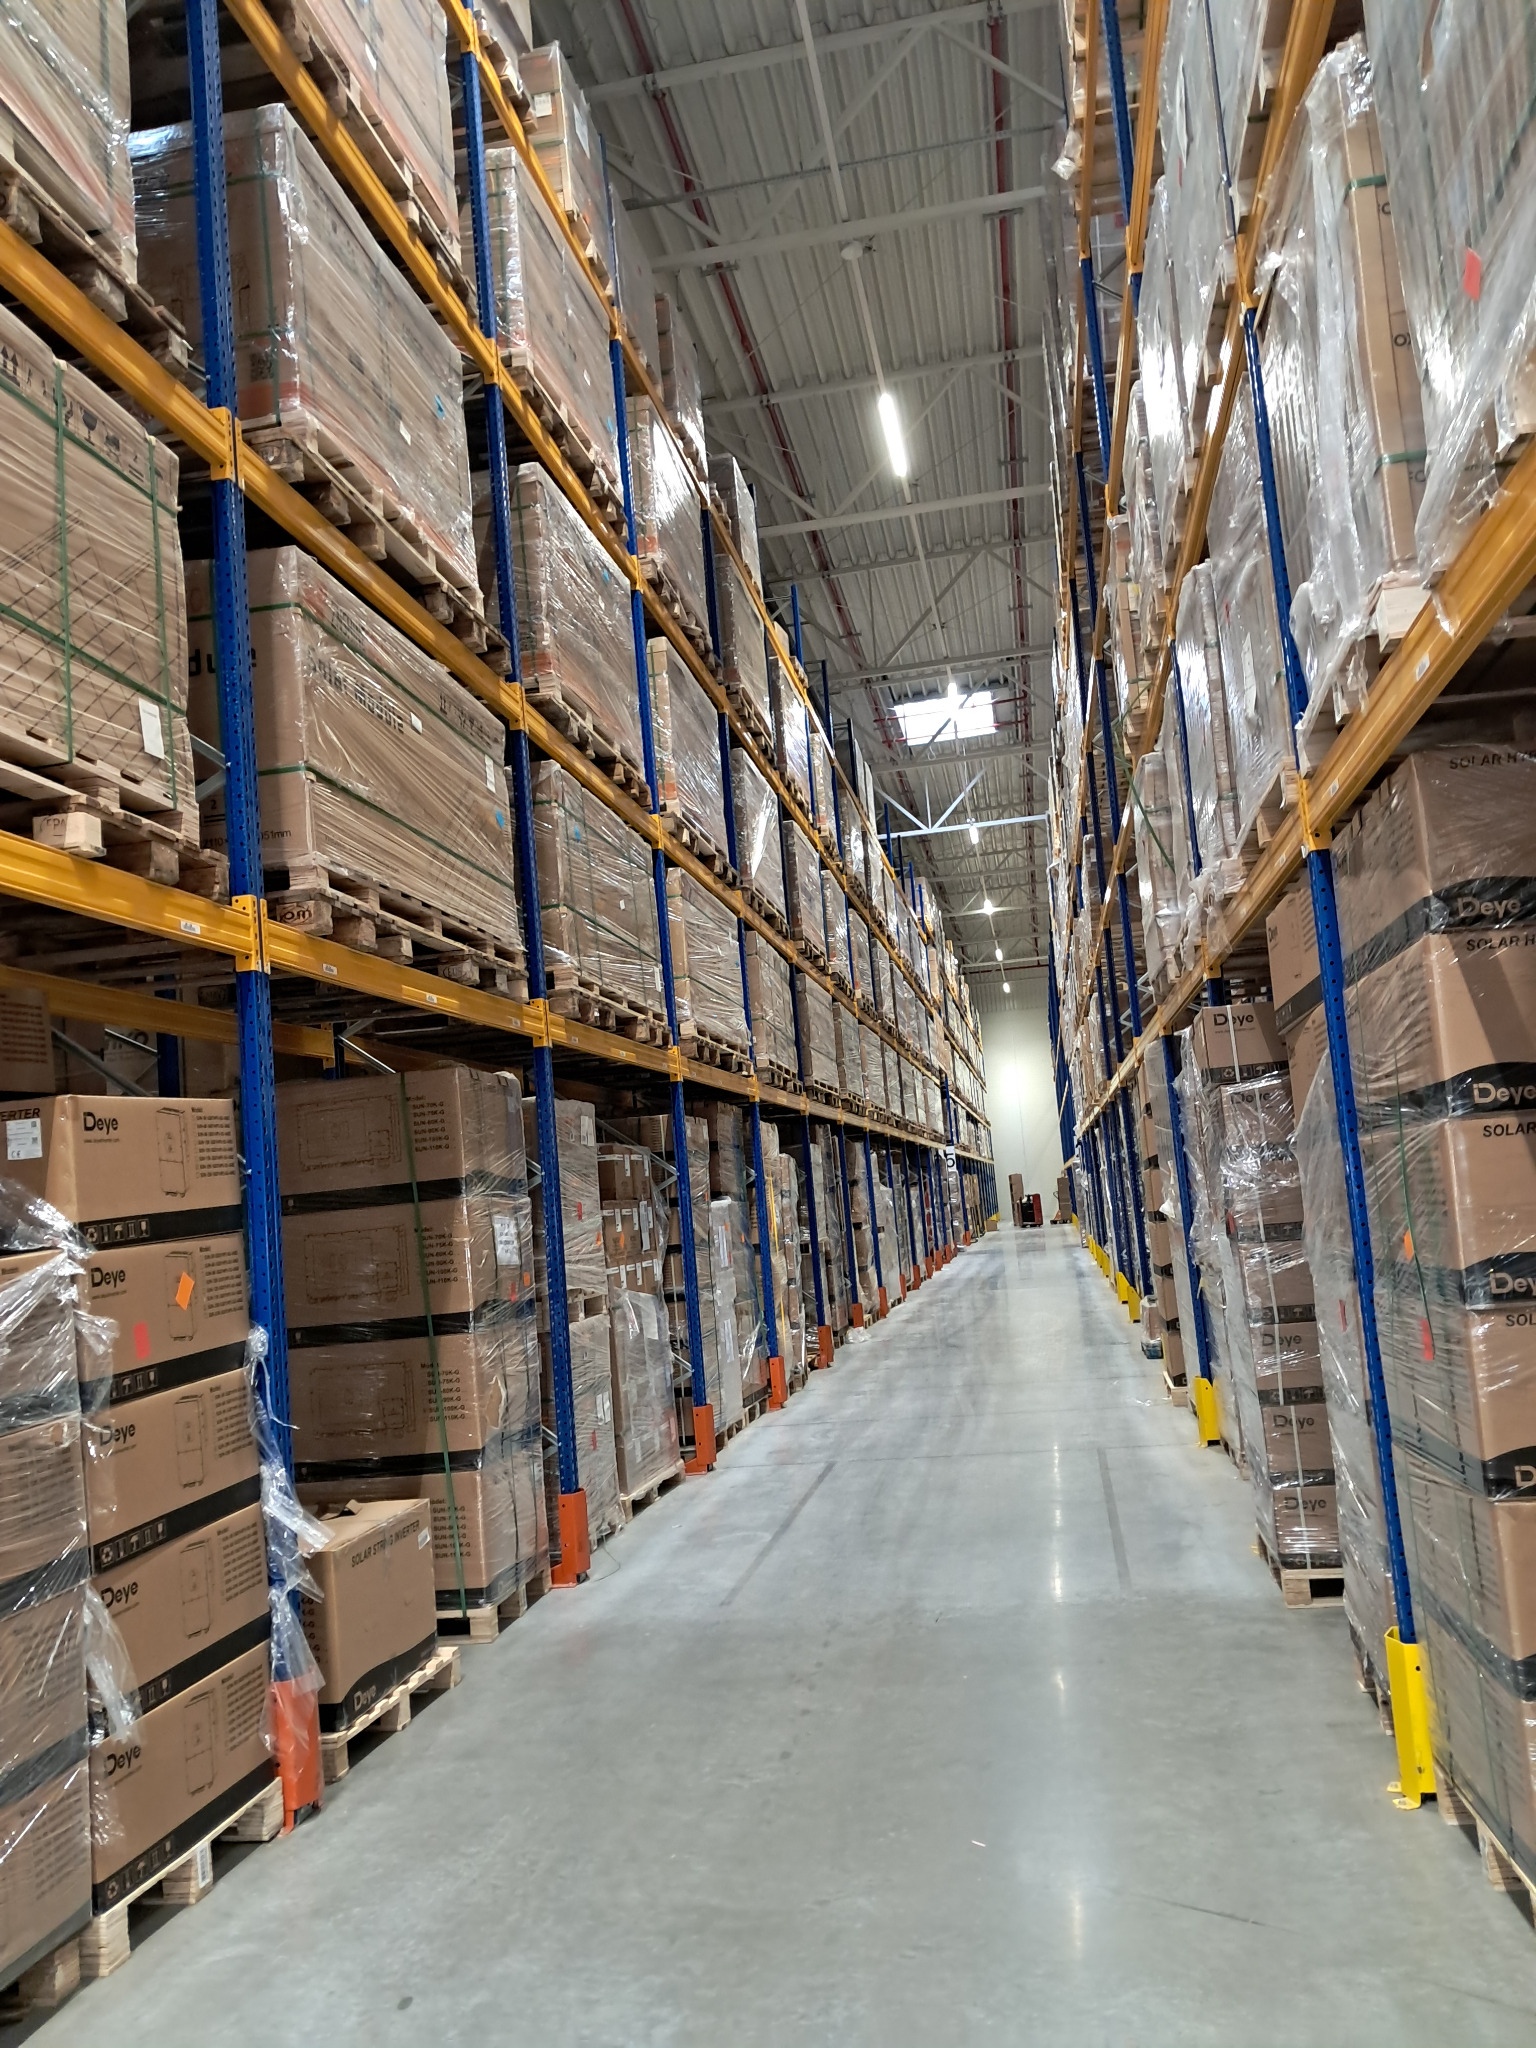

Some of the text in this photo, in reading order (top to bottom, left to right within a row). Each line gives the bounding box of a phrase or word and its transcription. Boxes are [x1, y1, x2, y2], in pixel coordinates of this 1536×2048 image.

[1458, 896, 1521, 919] Deye
[1466, 935, 1520, 952] SOLAR
[1231, 1092, 1271, 1105] Dee
[1473, 1082, 1536, 1105] Deye
[83, 1112, 119, 1135] Deye
[91, 1267, 126, 1289] Deye
[99, 1422, 136, 1447] Deye
[352, 1520, 420, 1568] SOLAR STRG INVERTER
[101, 1580, 139, 1609] Deye
[354, 1684, 377, 1712] Deye
[104, 1744, 142, 1776] Deye
